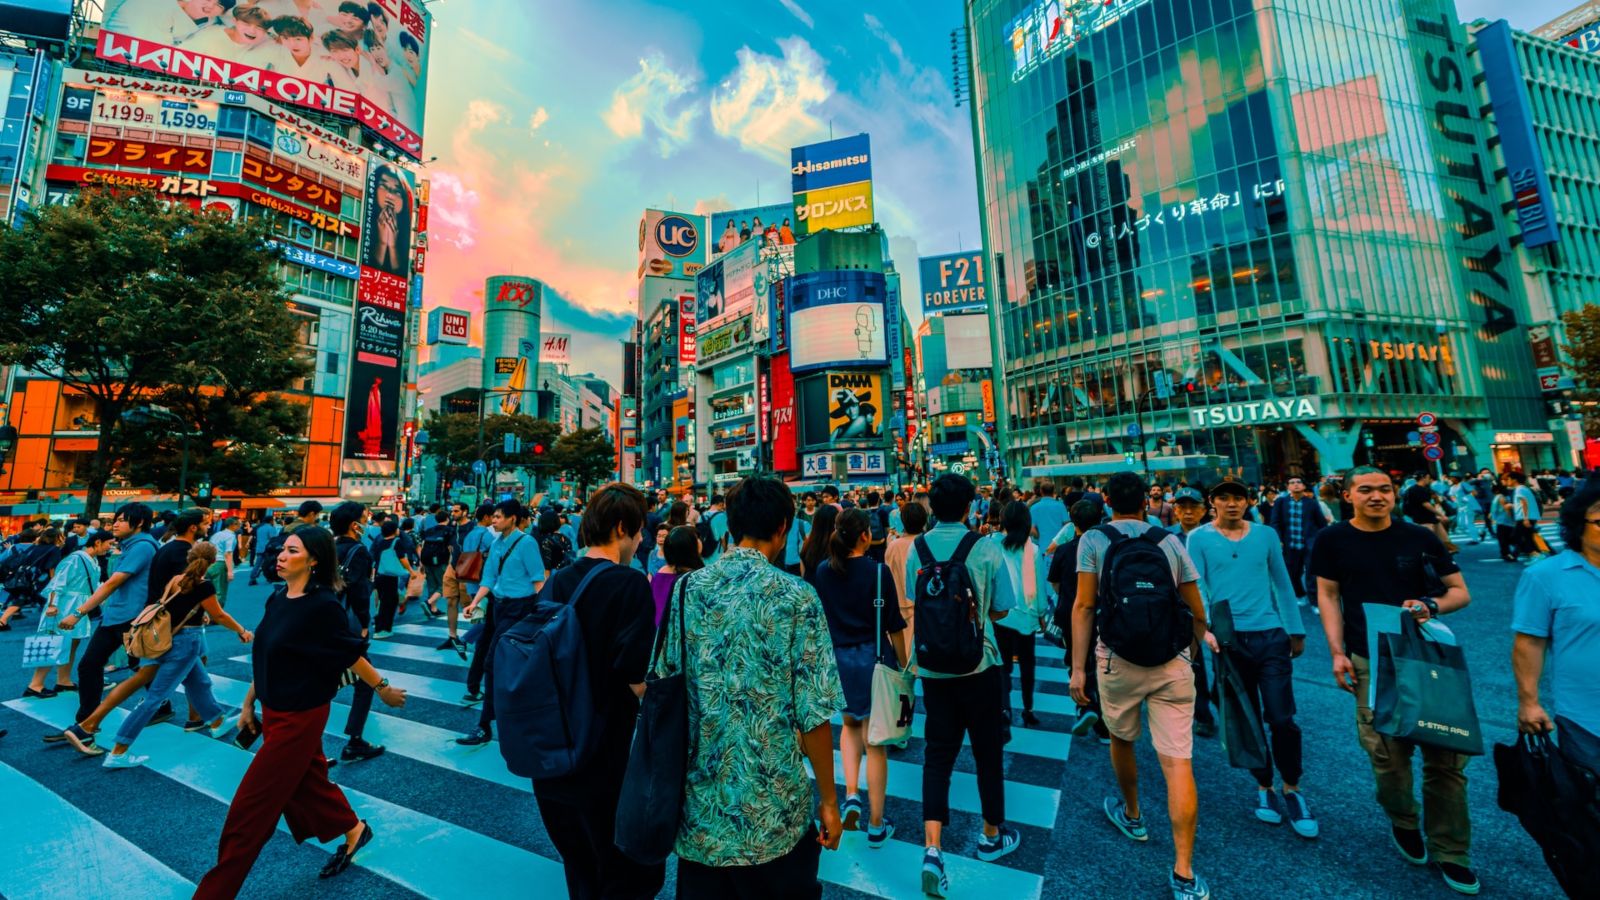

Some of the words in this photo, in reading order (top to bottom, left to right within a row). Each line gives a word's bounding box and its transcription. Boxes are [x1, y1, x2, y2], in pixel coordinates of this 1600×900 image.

[1580, 25, 1600, 53] B
[84, 73, 213, 98] しゃぶしゃぶバイキング
[66, 96, 91, 110] 9F
[360, 103, 420, 151] ワナワン
[91, 140, 207, 168] プライス
[792, 154, 868, 175] Hisamitsu
[160, 176, 217, 196] ガスト
[243, 158, 338, 205] コンタクト
[1415, 13, 1517, 340] TSUTAYA
[795, 195, 868, 221] サロンパス
[1512, 167, 1547, 234] SEIBU
[310, 212, 352, 236] ガスト
[361, 270, 407, 288] ユリゴコロ
[939, 256, 984, 288] F21
[496, 284, 534, 307] 109
[817, 286, 847, 300] DHC
[925, 286, 985, 306] FOREVER
[445, 314, 464, 326] UNI
[445, 324, 465, 335] QLO
[831, 374, 872, 389] DMM
[832, 388, 859, 404] FX
[1193, 398, 1317, 426] TSUTAYA
[806, 454, 881, 472] 大盛書店
[1418, 720, 1449, 732] G-STAR
[1450, 727, 1469, 737] RAW
